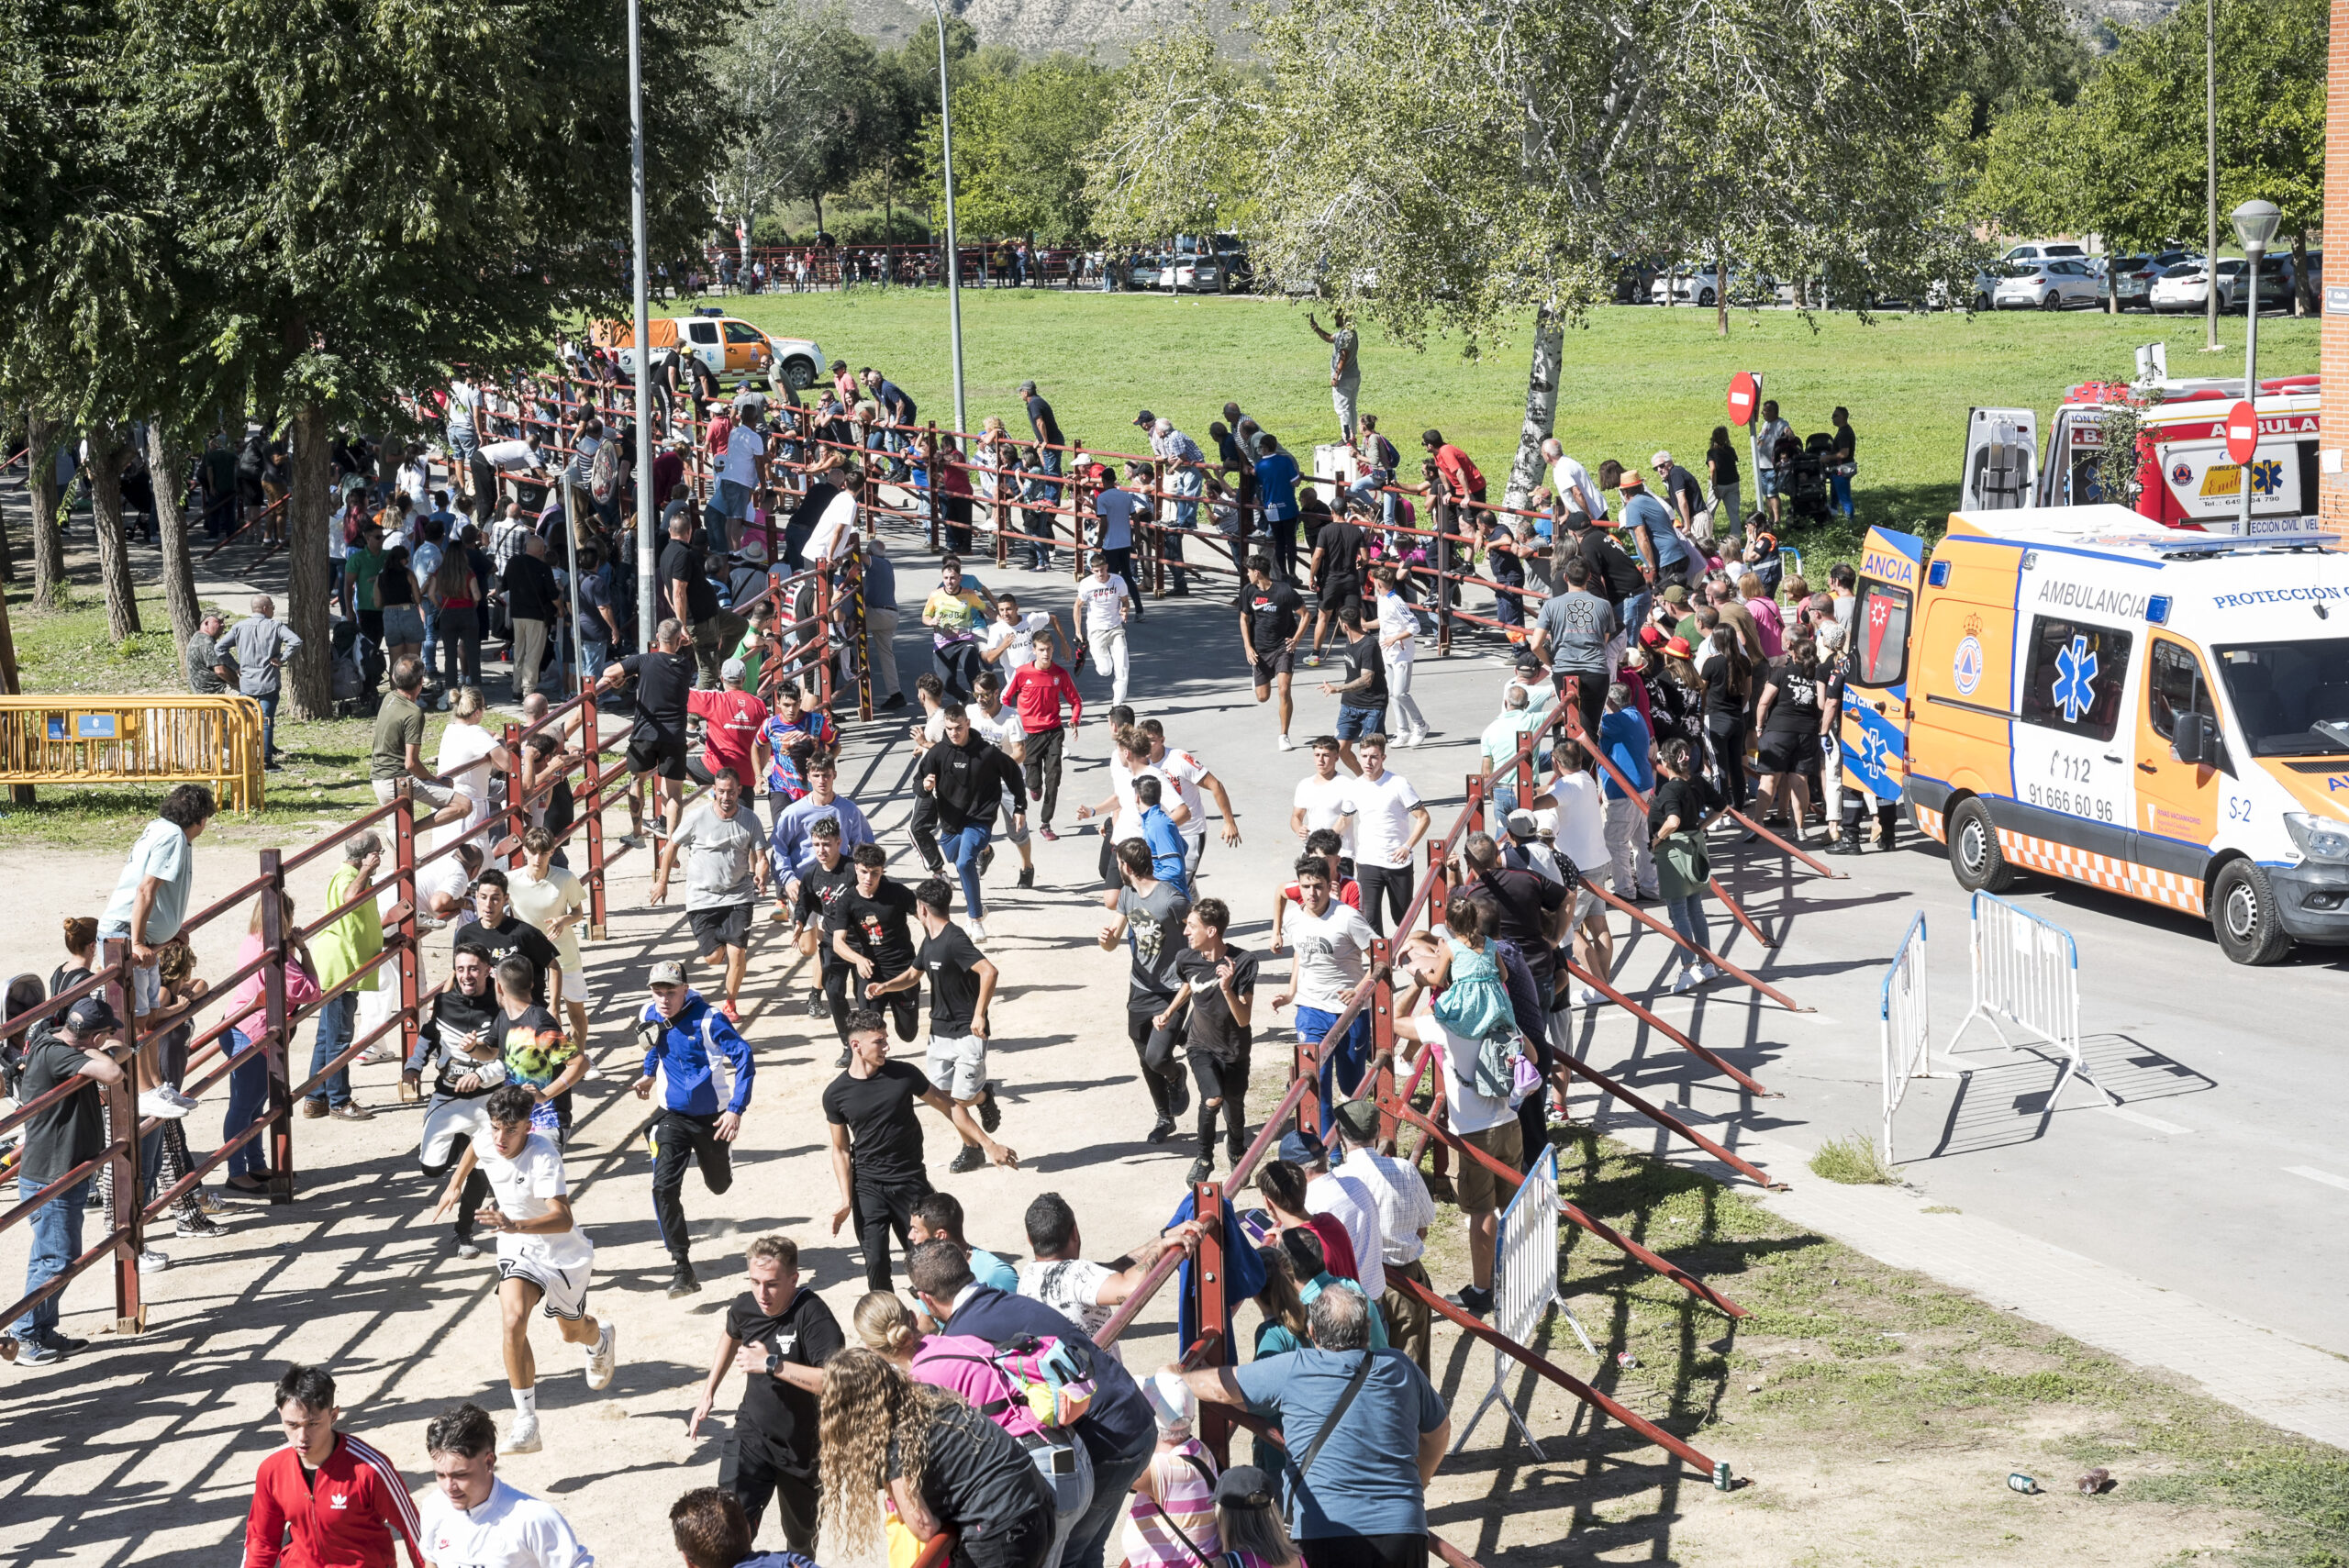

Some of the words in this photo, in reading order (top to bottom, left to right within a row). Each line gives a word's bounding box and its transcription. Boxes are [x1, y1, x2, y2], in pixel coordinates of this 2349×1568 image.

[2282, 518, 2299, 532] CIVIL
[1255, 596, 1269, 605] JUST
[2038, 579, 2146, 620] AMBULANCIA
[2212, 584, 2342, 609] PROTECCIÓN
[2064, 755, 2091, 784] 112
[2029, 783, 2043, 806] 91
[2046, 786, 2071, 813] 666
[2075, 794, 2091, 817] 60
[2096, 798, 2113, 823] 96
[2229, 795, 2252, 823] S-2
